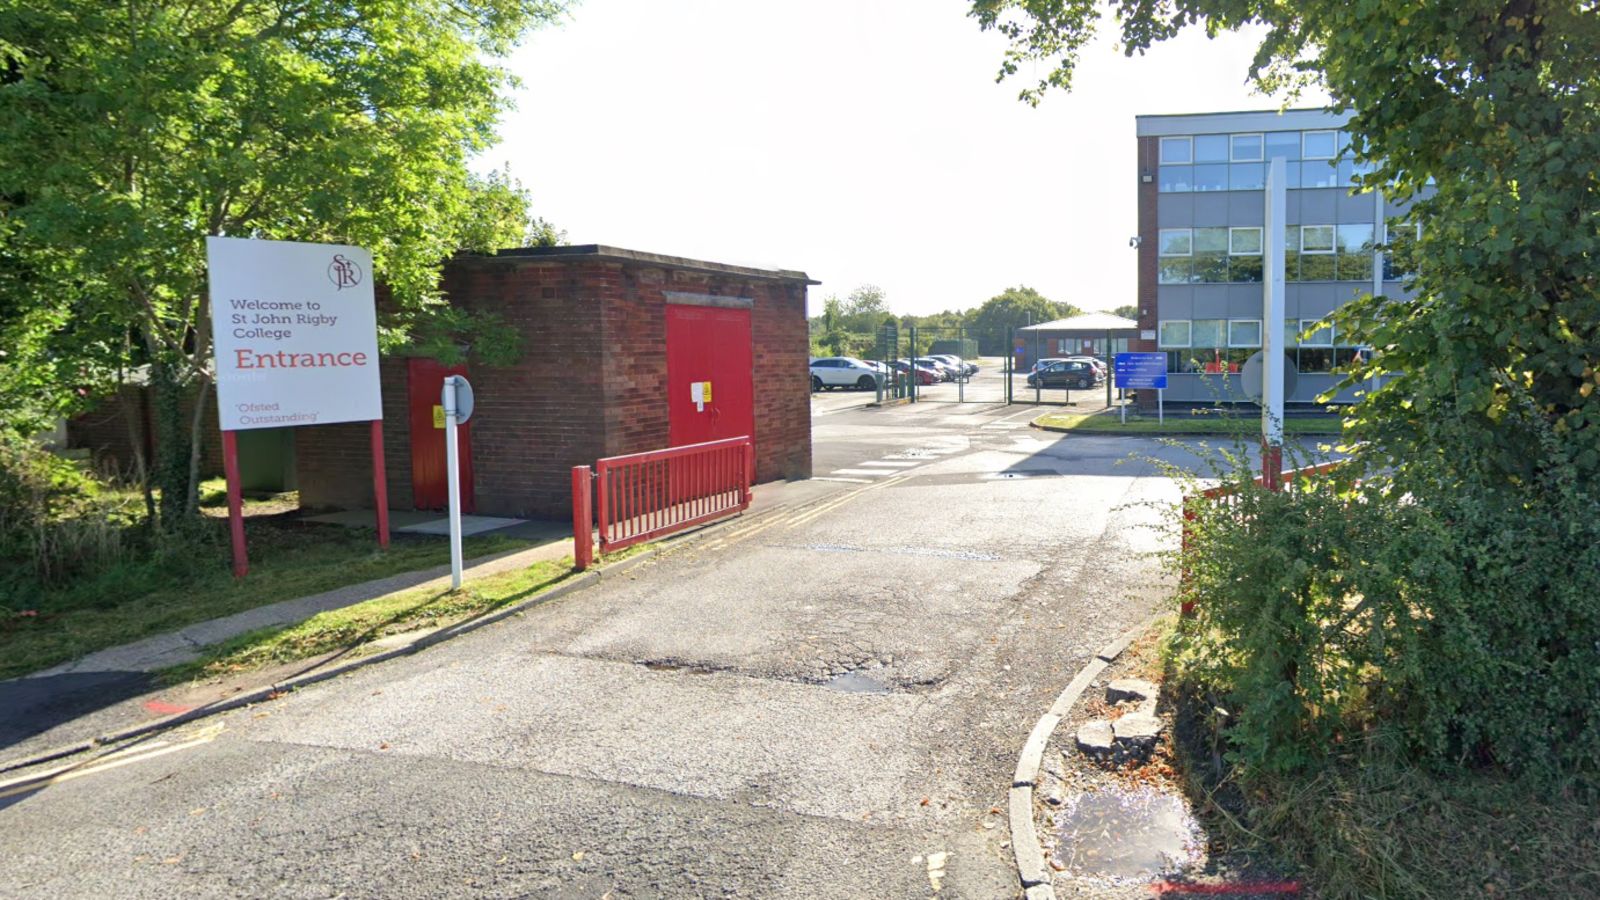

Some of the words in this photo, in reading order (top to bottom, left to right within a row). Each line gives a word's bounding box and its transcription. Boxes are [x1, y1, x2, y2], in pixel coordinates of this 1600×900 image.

[230, 299, 303, 310] Welcome
[306, 301, 321, 310] to
[232, 314, 248, 324] St
[252, 314, 292, 324] John
[296, 314, 338, 326] Rigby
[233, 328, 292, 340] College
[234, 349, 368, 368] Entrance
